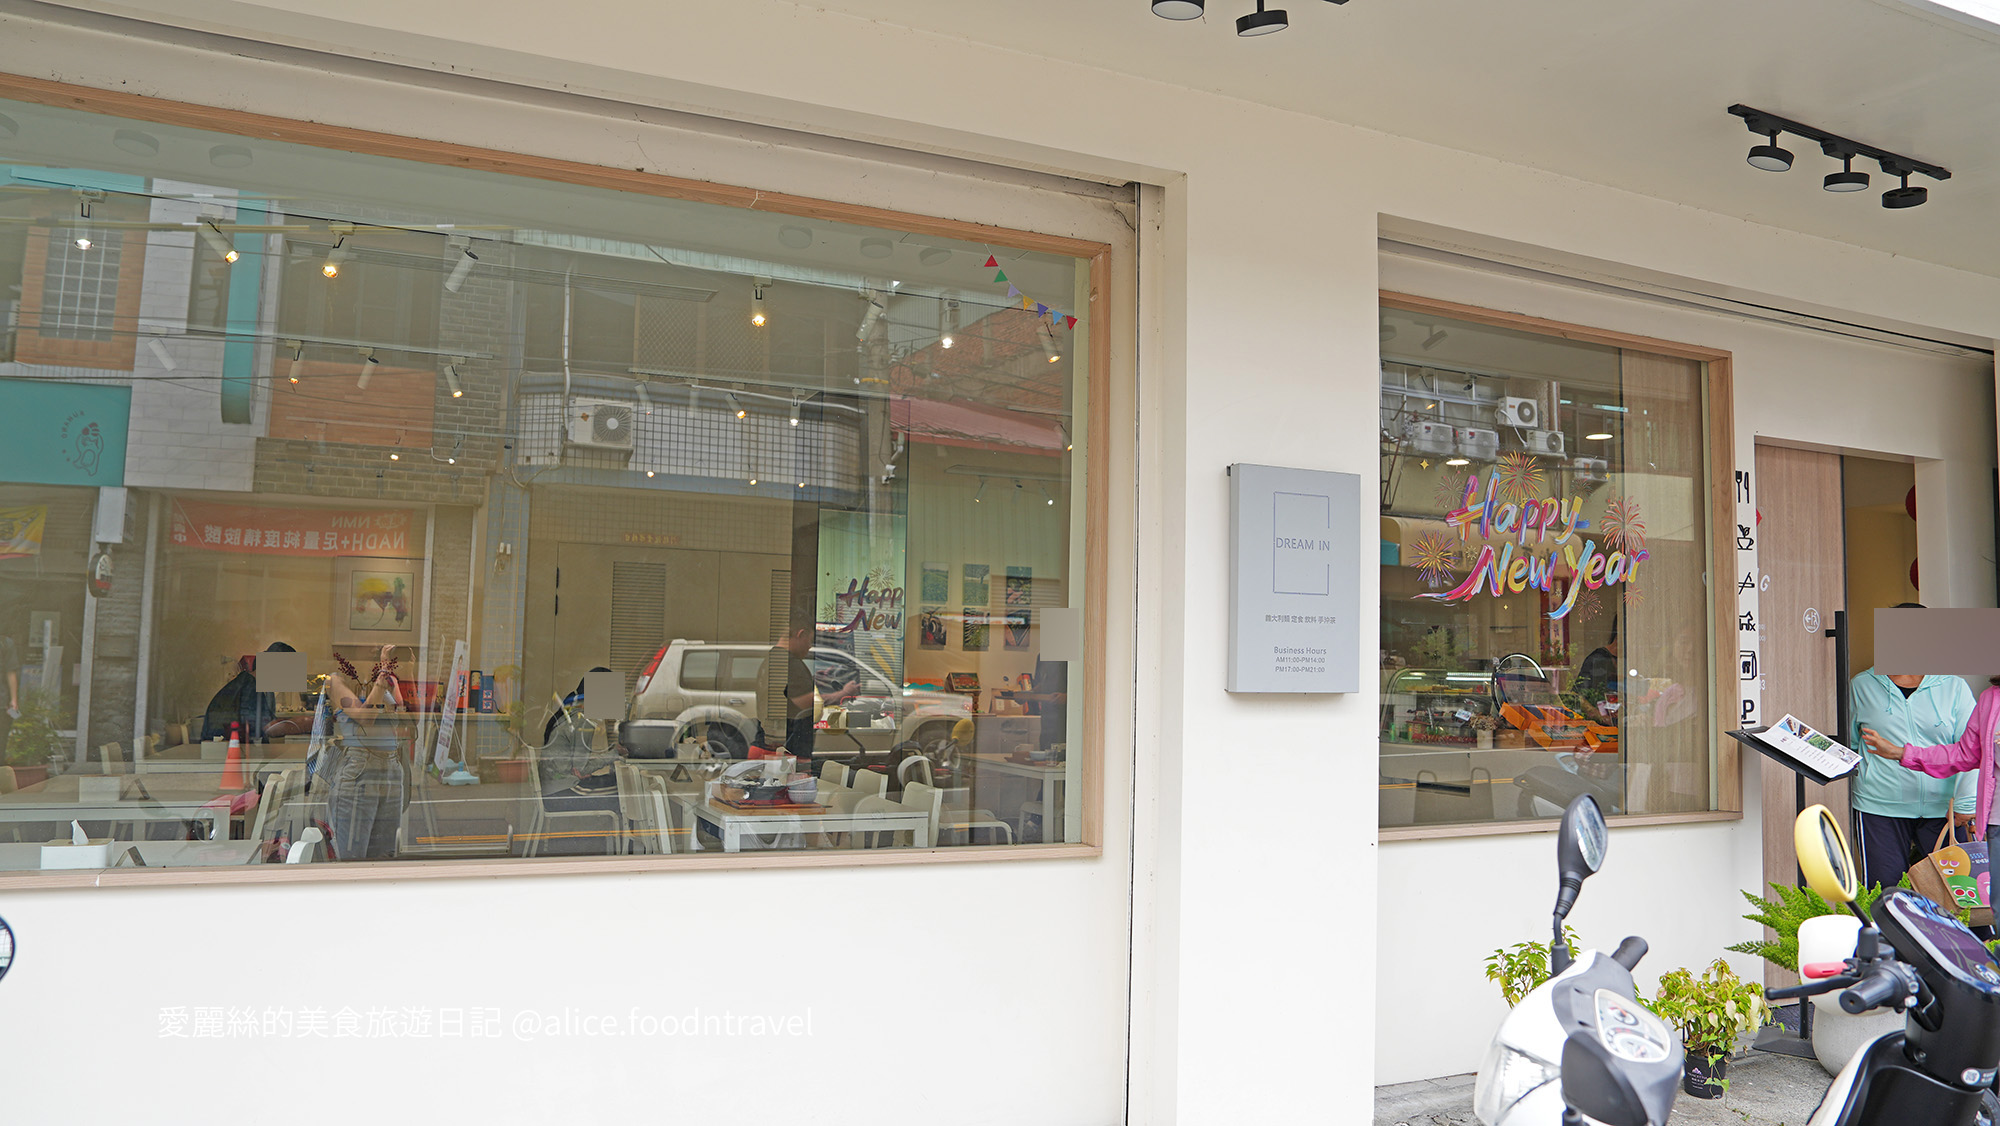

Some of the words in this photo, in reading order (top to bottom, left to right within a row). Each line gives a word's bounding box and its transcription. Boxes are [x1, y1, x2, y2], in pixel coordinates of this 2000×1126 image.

[1446, 465, 1590, 545] Happy
[1276, 537, 1314, 550] DREAM
[1319, 540, 1330, 551] IN
[1410, 541, 1558, 602] New
[1547, 540, 1650, 620] Year
[838, 607, 902, 633] New
[1273, 646, 1304, 655] Business
[1305, 647, 1327, 655] Hours
[1275, 656, 1326, 664] AM11:00-PM14:00
[1275, 665, 1326, 673] PM17:00-PM21:00
